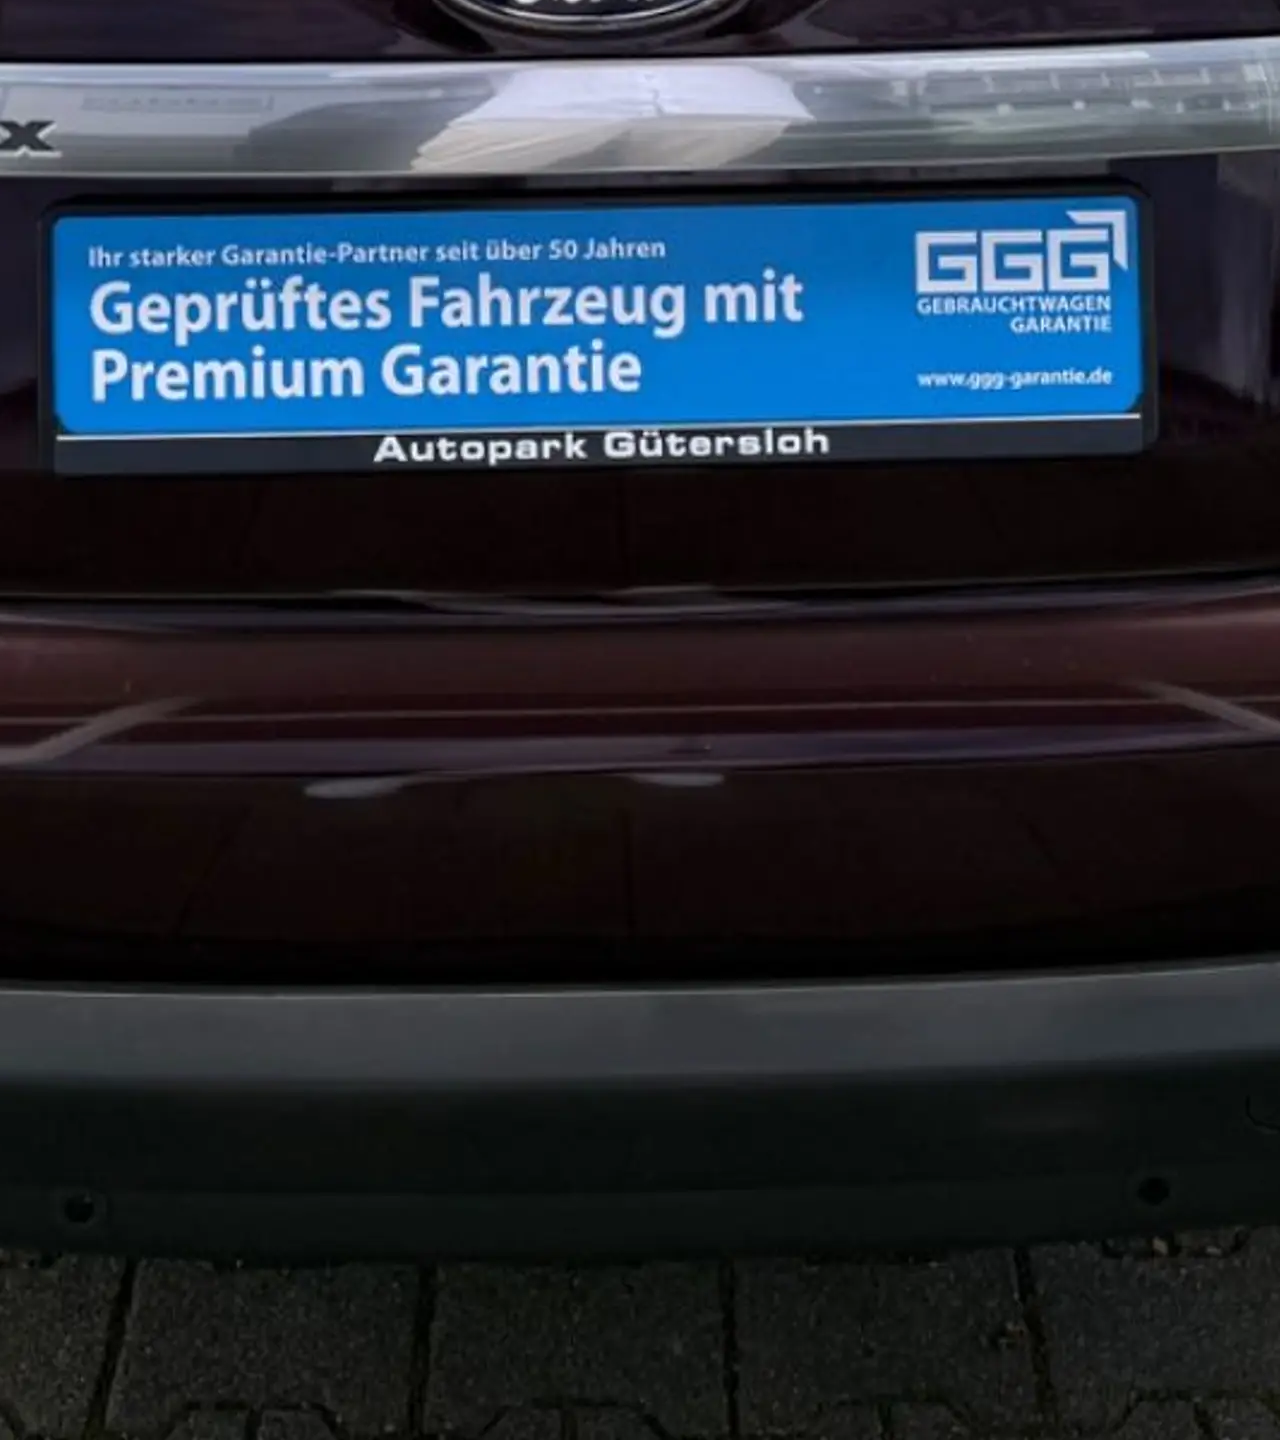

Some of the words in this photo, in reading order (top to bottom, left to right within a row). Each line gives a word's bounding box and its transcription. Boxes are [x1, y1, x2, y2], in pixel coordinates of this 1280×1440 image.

[88, 246, 123, 268] Ihr
[129, 245, 216, 268] starker
[221, 241, 429, 267] Garantie-Partner
[435, 240, 480, 262] seit
[486, 238, 543, 261] über
[549, 239, 578, 260] 50
[583, 237, 666, 260] Jahren
[915, 229, 1111, 293] GGG
[89, 274, 392, 348] Geprüftes
[409, 272, 686, 339] Fahrzeug
[704, 268, 804, 323] mit
[916, 295, 1112, 315] GEBRAUCHTWAGEN
[1009, 315, 1112, 334] GARANTIE
[91, 345, 365, 402] Premium
[381, 338, 643, 396] Garantie
[917, 367, 1113, 391] www.ggg-garantie.de
[373, 430, 588, 466] Autopark
[603, 427, 830, 460] Gütersloh
